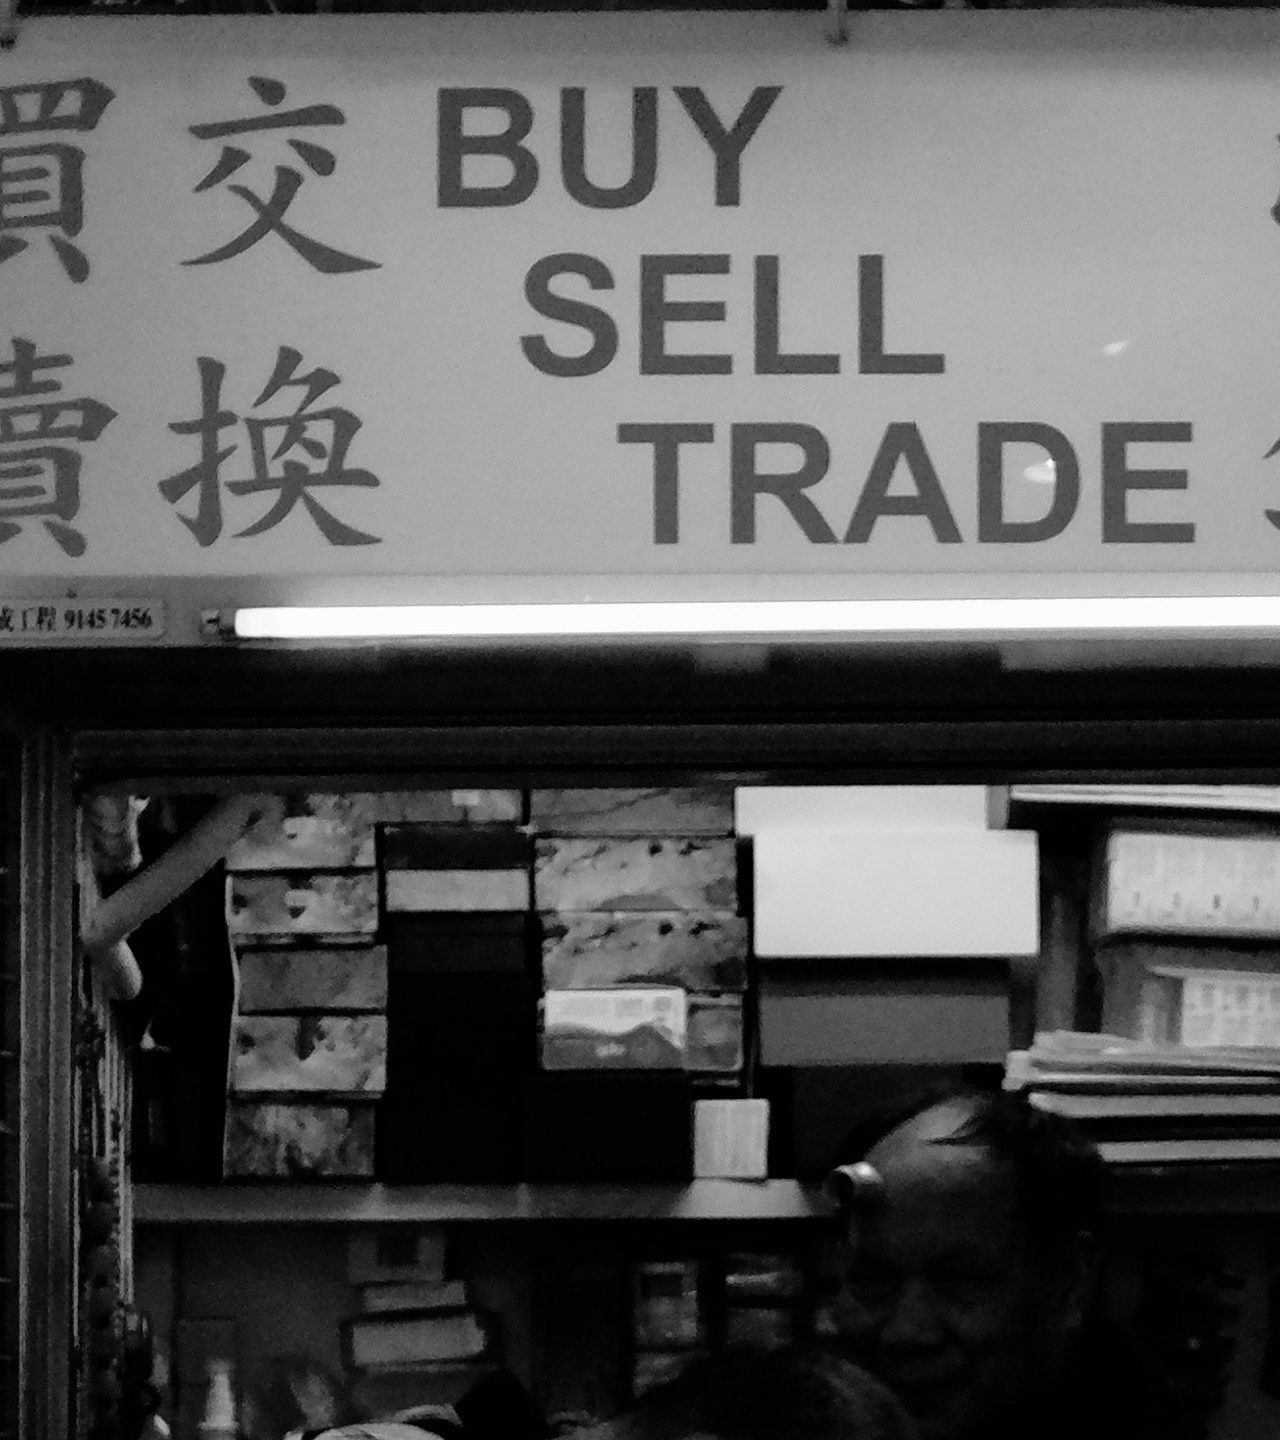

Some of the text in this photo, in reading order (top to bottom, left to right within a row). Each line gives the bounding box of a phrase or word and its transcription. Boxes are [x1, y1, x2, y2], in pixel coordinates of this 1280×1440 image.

[436, 84, 785, 210] BUY
[157, 74, 383, 548] 交換
[519, 251, 946, 378] SELL
[616, 420, 1196, 545] TRADE
